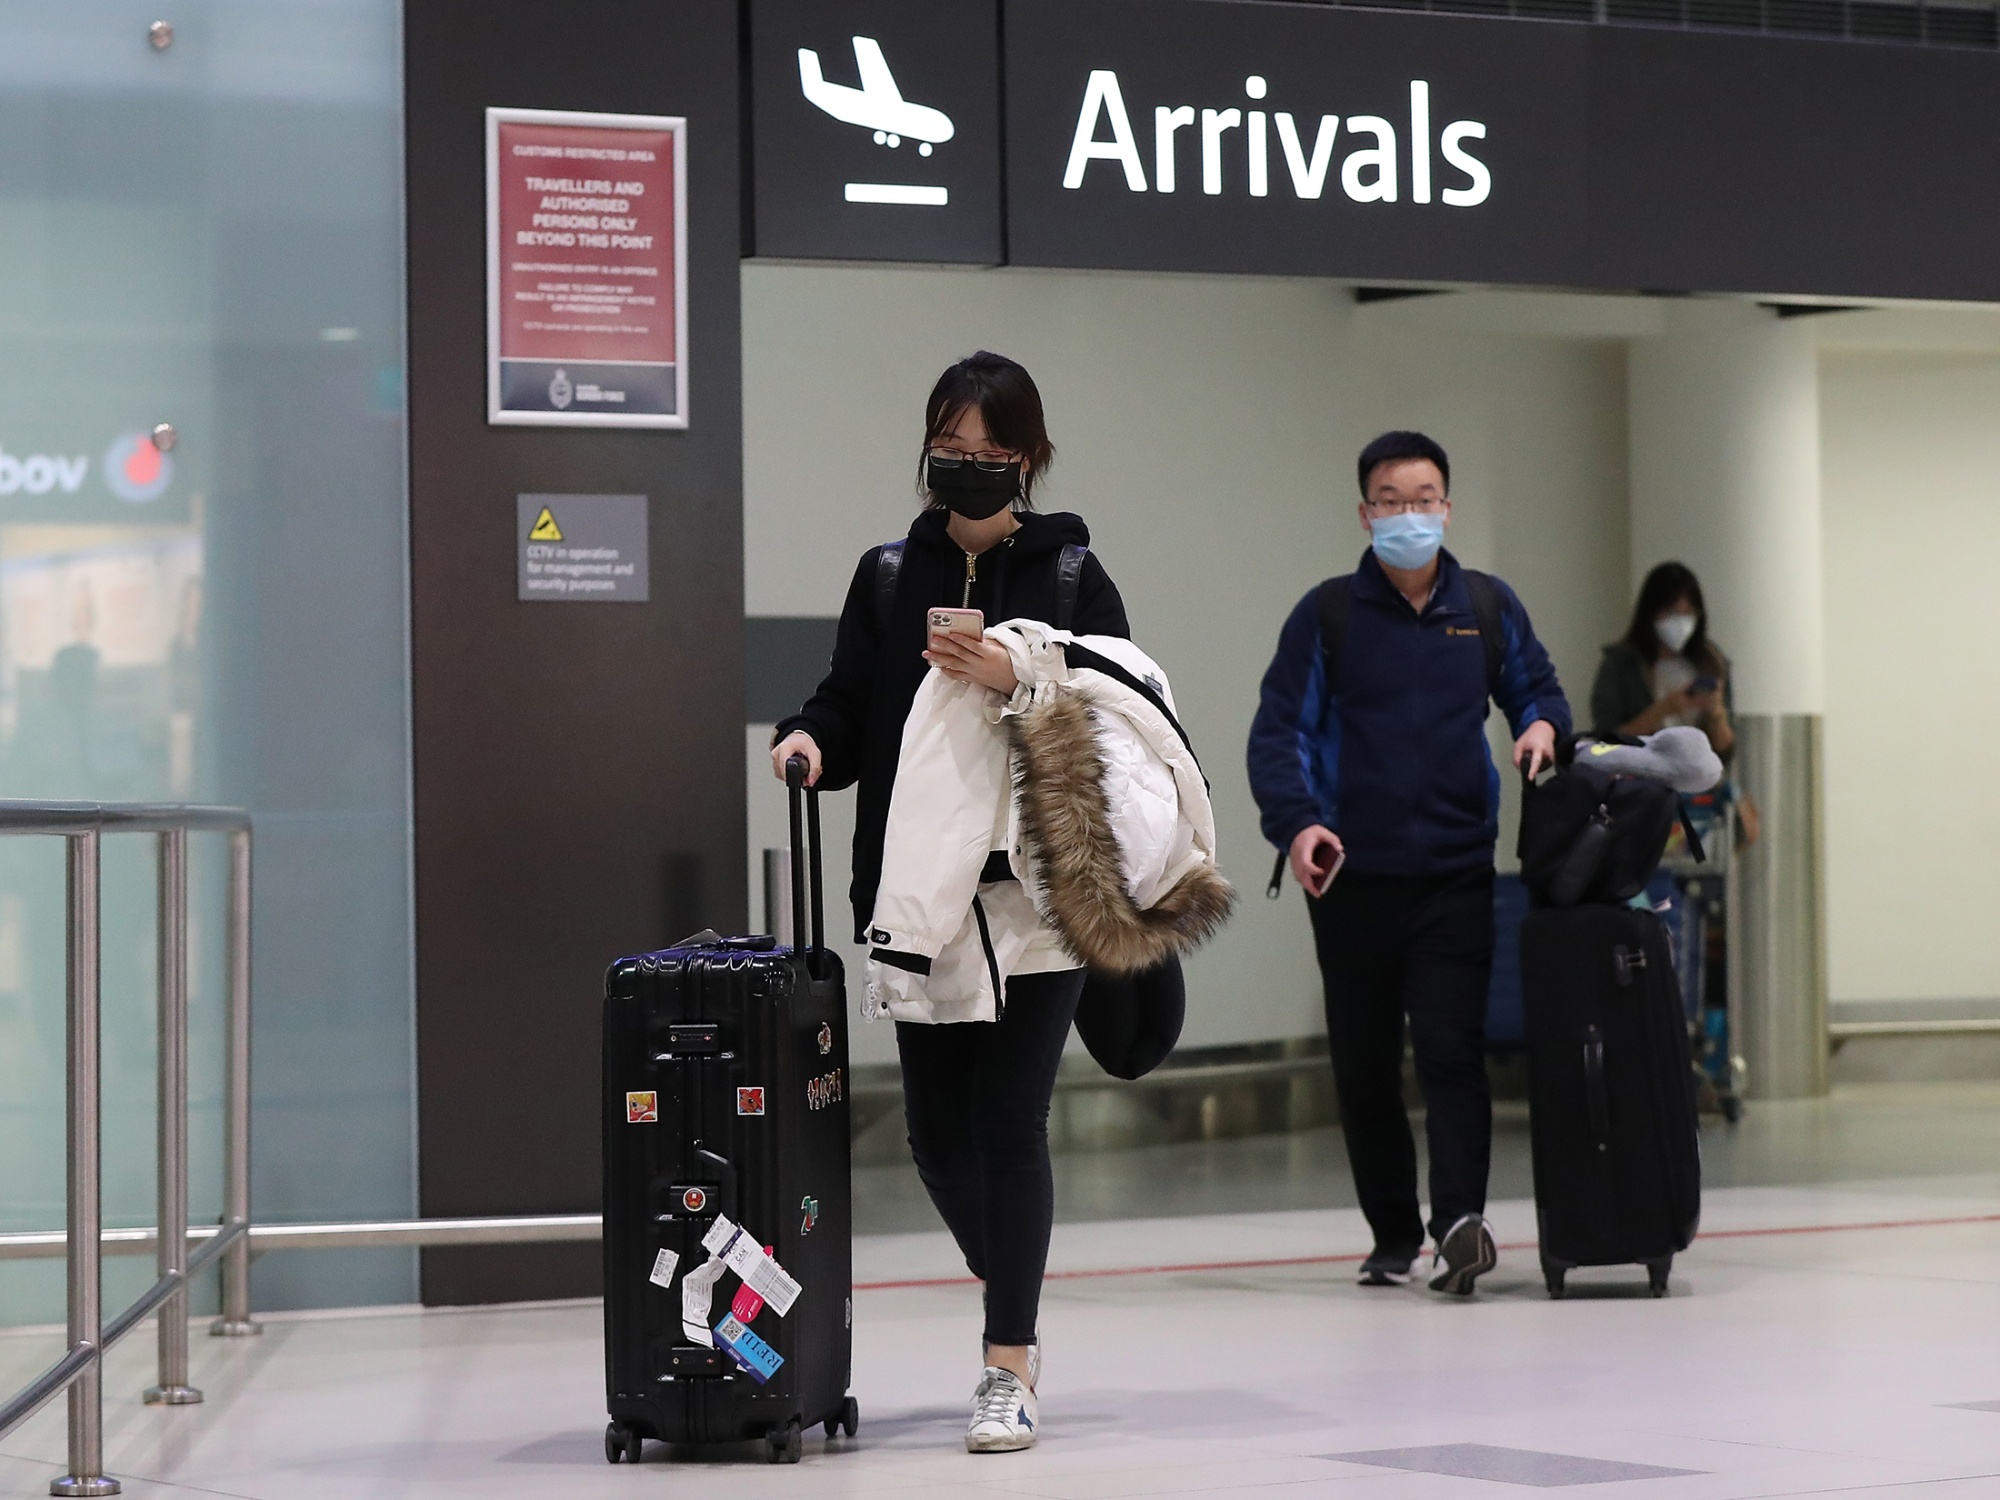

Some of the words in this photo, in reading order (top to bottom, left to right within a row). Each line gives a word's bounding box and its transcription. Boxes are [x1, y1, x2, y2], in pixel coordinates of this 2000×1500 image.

[1062, 68, 1491, 207] Arrivals
[512, 145, 563, 158] CUSTOMS
[564, 147, 627, 161] RESTRICTED
[628, 150, 656, 162] AREA
[525, 176, 613, 194] TRAVELLERS
[614, 181, 645, 196] AND
[540, 196, 630, 213] AUTHORISED
[532, 213, 599, 230] PERSONS
[600, 216, 637, 231] ONLY
[516, 231, 576, 247] BEYOND
[577, 233, 610, 248] THIS
[611, 235, 654, 249] POINT
[526, 545, 554, 559] CCTV
[555, 547, 567, 559] in
[568, 548, 619, 561] operation
[526, 560, 543, 574] for
[543, 563, 613, 577] management
[613, 562, 635, 576] and
[527, 578, 567, 593] security
[741, 1331, 780, 1369] RFID
